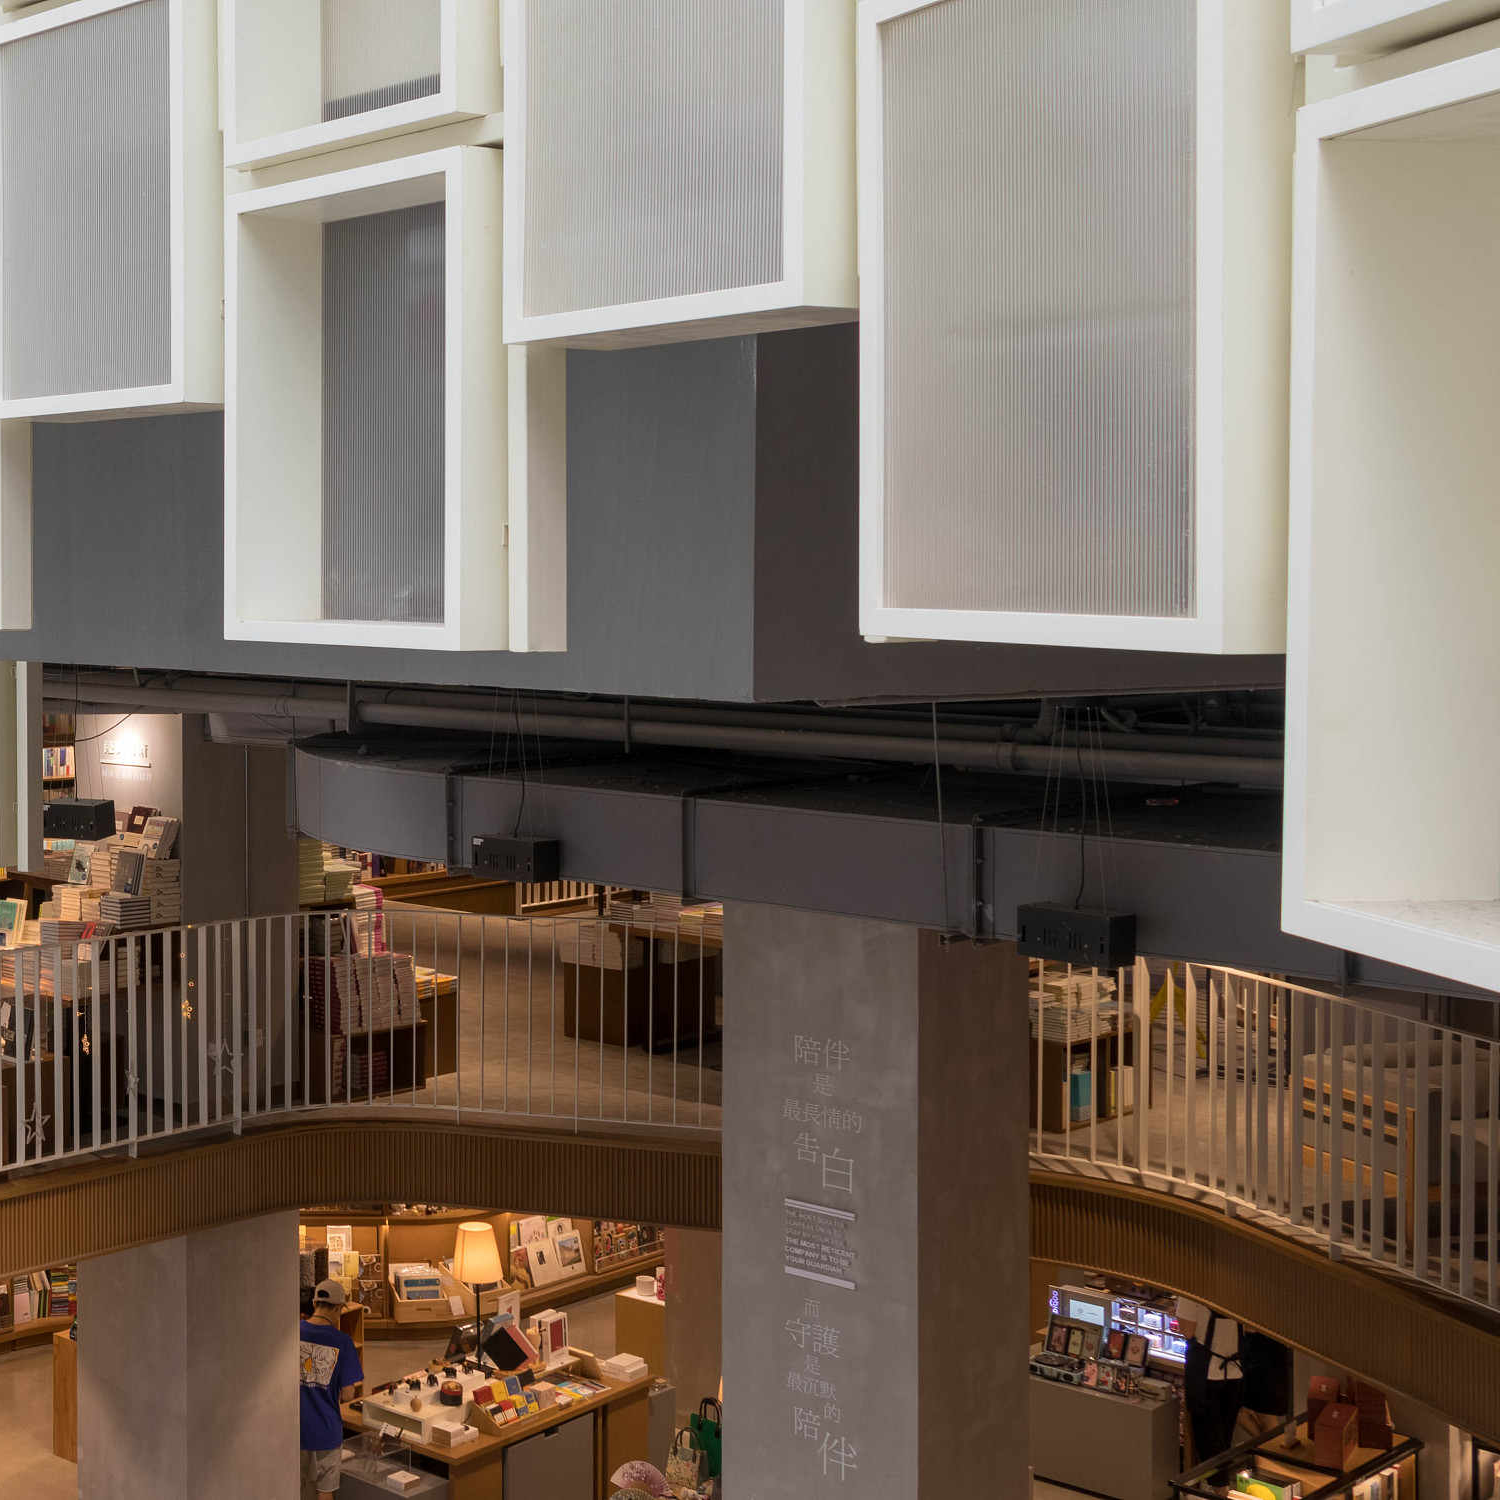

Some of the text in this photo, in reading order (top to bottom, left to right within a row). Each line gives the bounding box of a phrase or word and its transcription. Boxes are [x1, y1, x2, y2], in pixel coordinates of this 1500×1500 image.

[794, 1033, 850, 1071] 陪伴
[812, 1073, 833, 1097] 是
[782, 1098, 862, 1134] 最長情的
[793, 1132, 854, 1194] 告白
[798, 1212, 816, 1221] MOST
[784, 1245, 820, 1259] COMPANY
[829, 1255, 839, 1264] TO
[840, 1258, 849, 1267] BE
[785, 1236, 856, 1259] THE MOST RETICENT
[785, 1254, 842, 1274] YOUR GUARDIAN
[804, 1298, 821, 1319] 而
[785, 1318, 841, 1359] 守護
[803, 1354, 821, 1376] 是
[786, 1370, 837, 1402] 最沉默
[823, 1402, 841, 1424] 的
[794, 1405, 858, 1482] 陪伴
